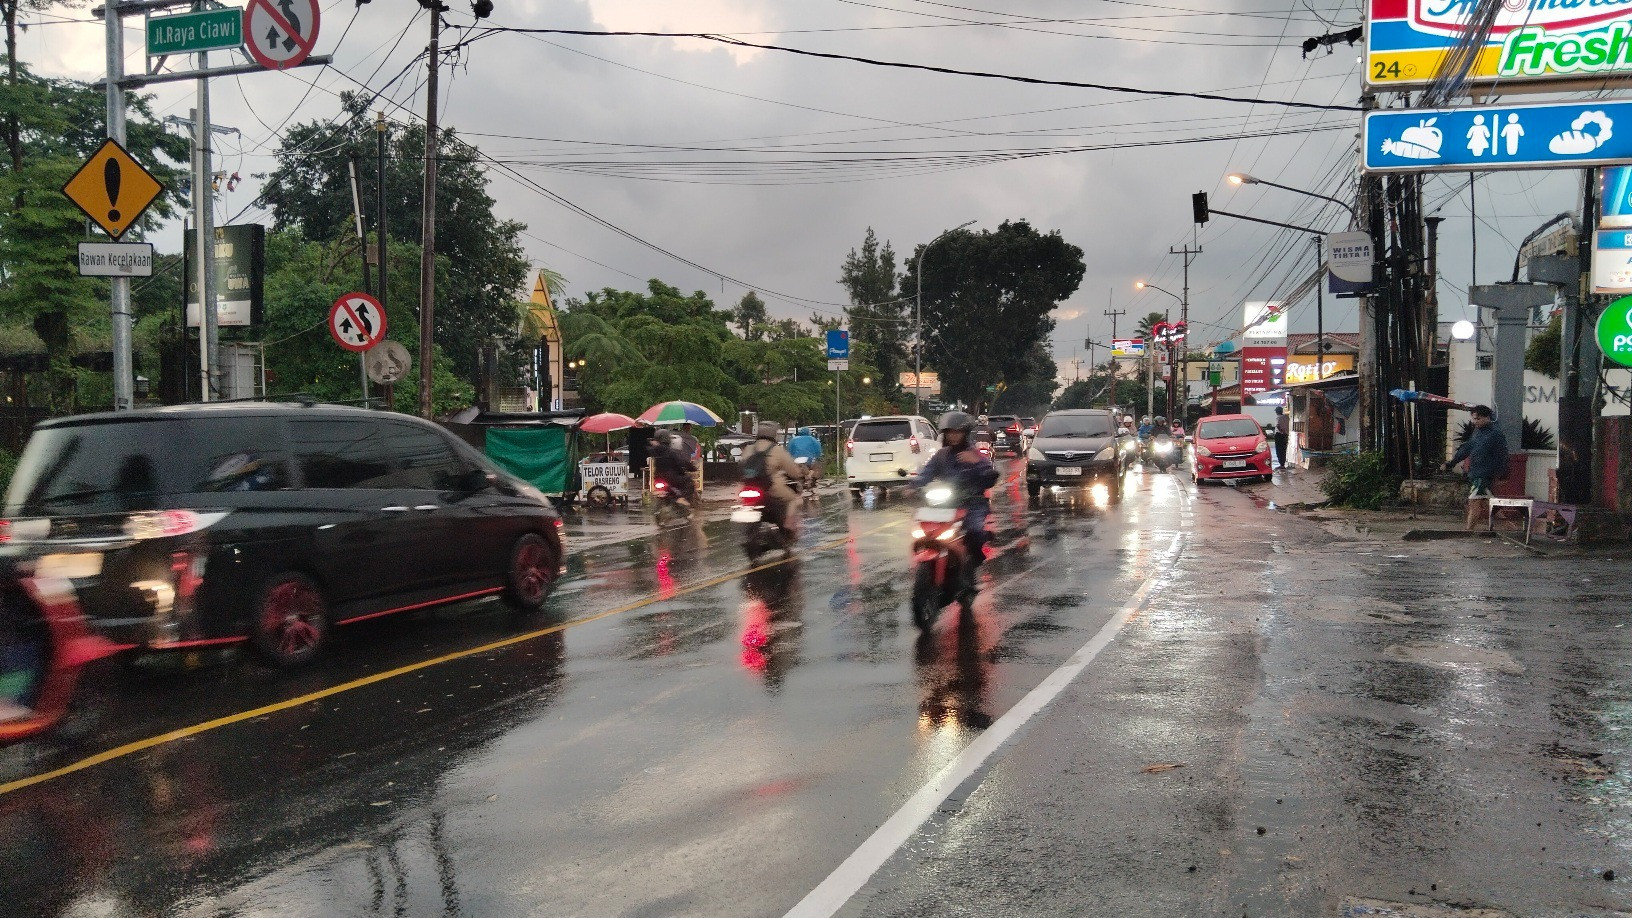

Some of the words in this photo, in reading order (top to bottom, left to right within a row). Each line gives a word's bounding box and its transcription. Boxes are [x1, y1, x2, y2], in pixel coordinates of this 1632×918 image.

[155, 26, 195, 47] Jl.Raya
[200, 17, 235, 40] Ciawi
[1504, 27, 1632, 71] Fresh
[1373, 60, 1401, 79] 24
[1332, 245, 1370, 253] WISMA
[80, 252, 106, 266] Rawan
[108, 252, 151, 267] Kecelakaan
[584, 467, 604, 477] TELOR
[595, 477, 619, 485] BASRENG
